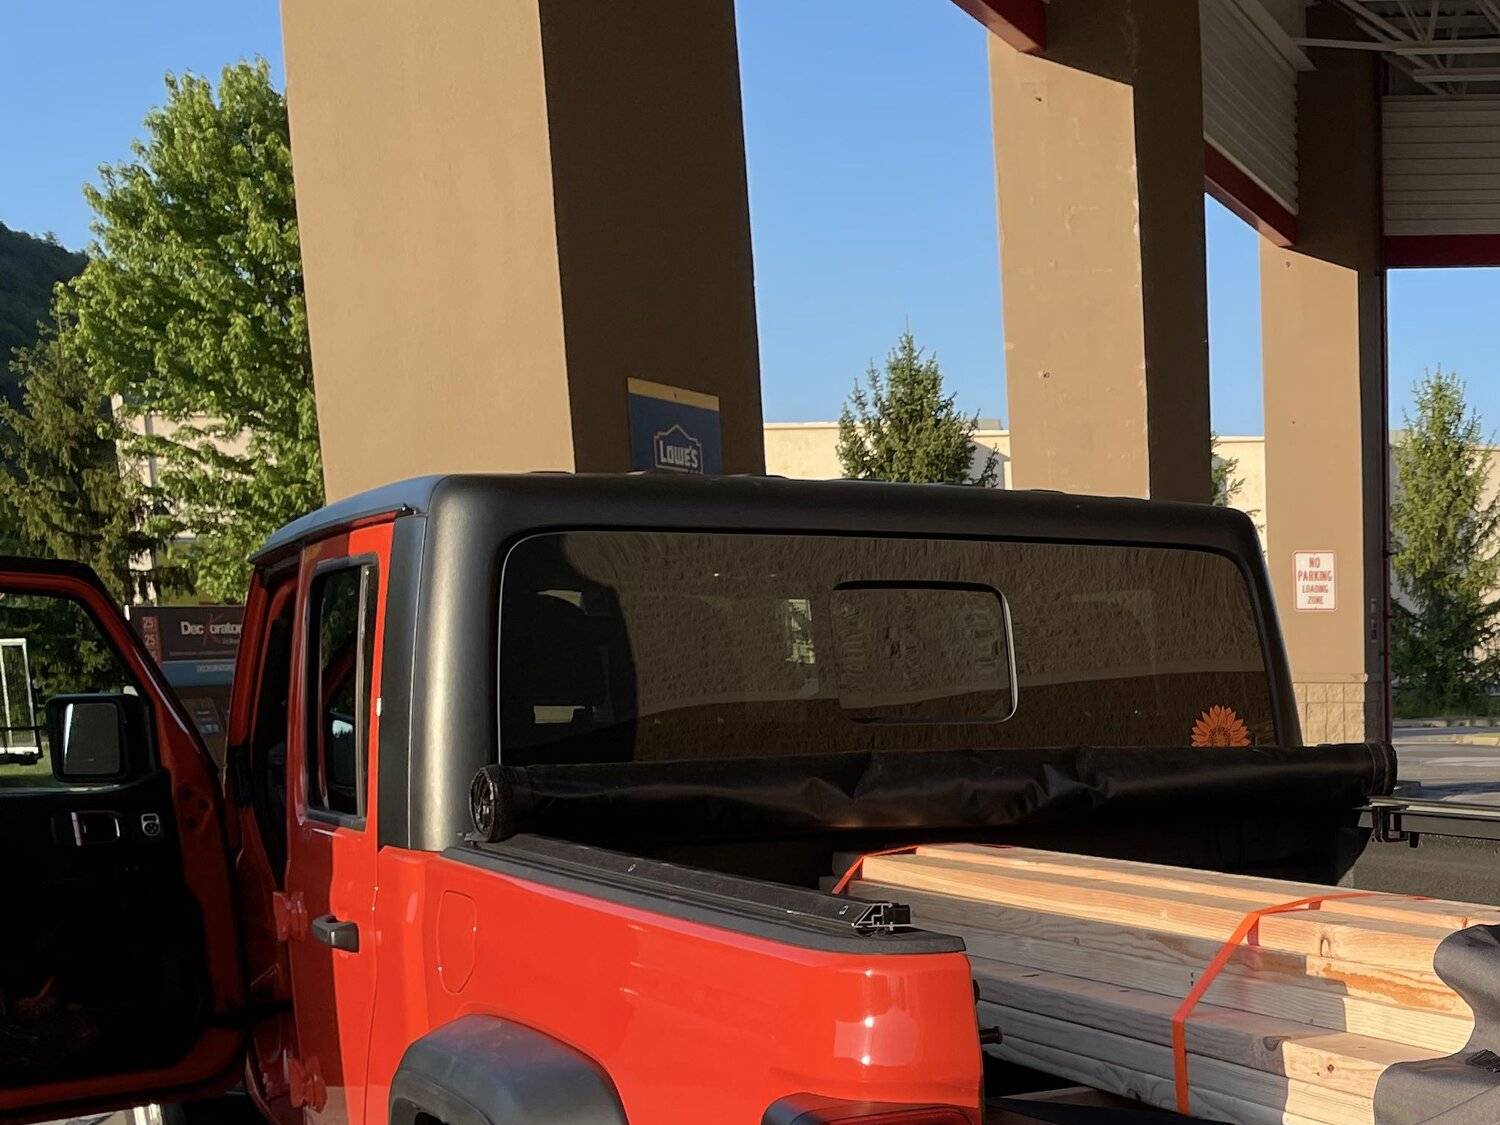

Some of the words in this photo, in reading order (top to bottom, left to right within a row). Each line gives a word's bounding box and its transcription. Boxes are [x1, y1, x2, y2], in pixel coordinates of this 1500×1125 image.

[1308, 557, 1321, 568] NO
[1297, 570, 1333, 582] PARKING
[1302, 584, 1329, 594] LOADING
[1307, 595, 1324, 605] ZONE
